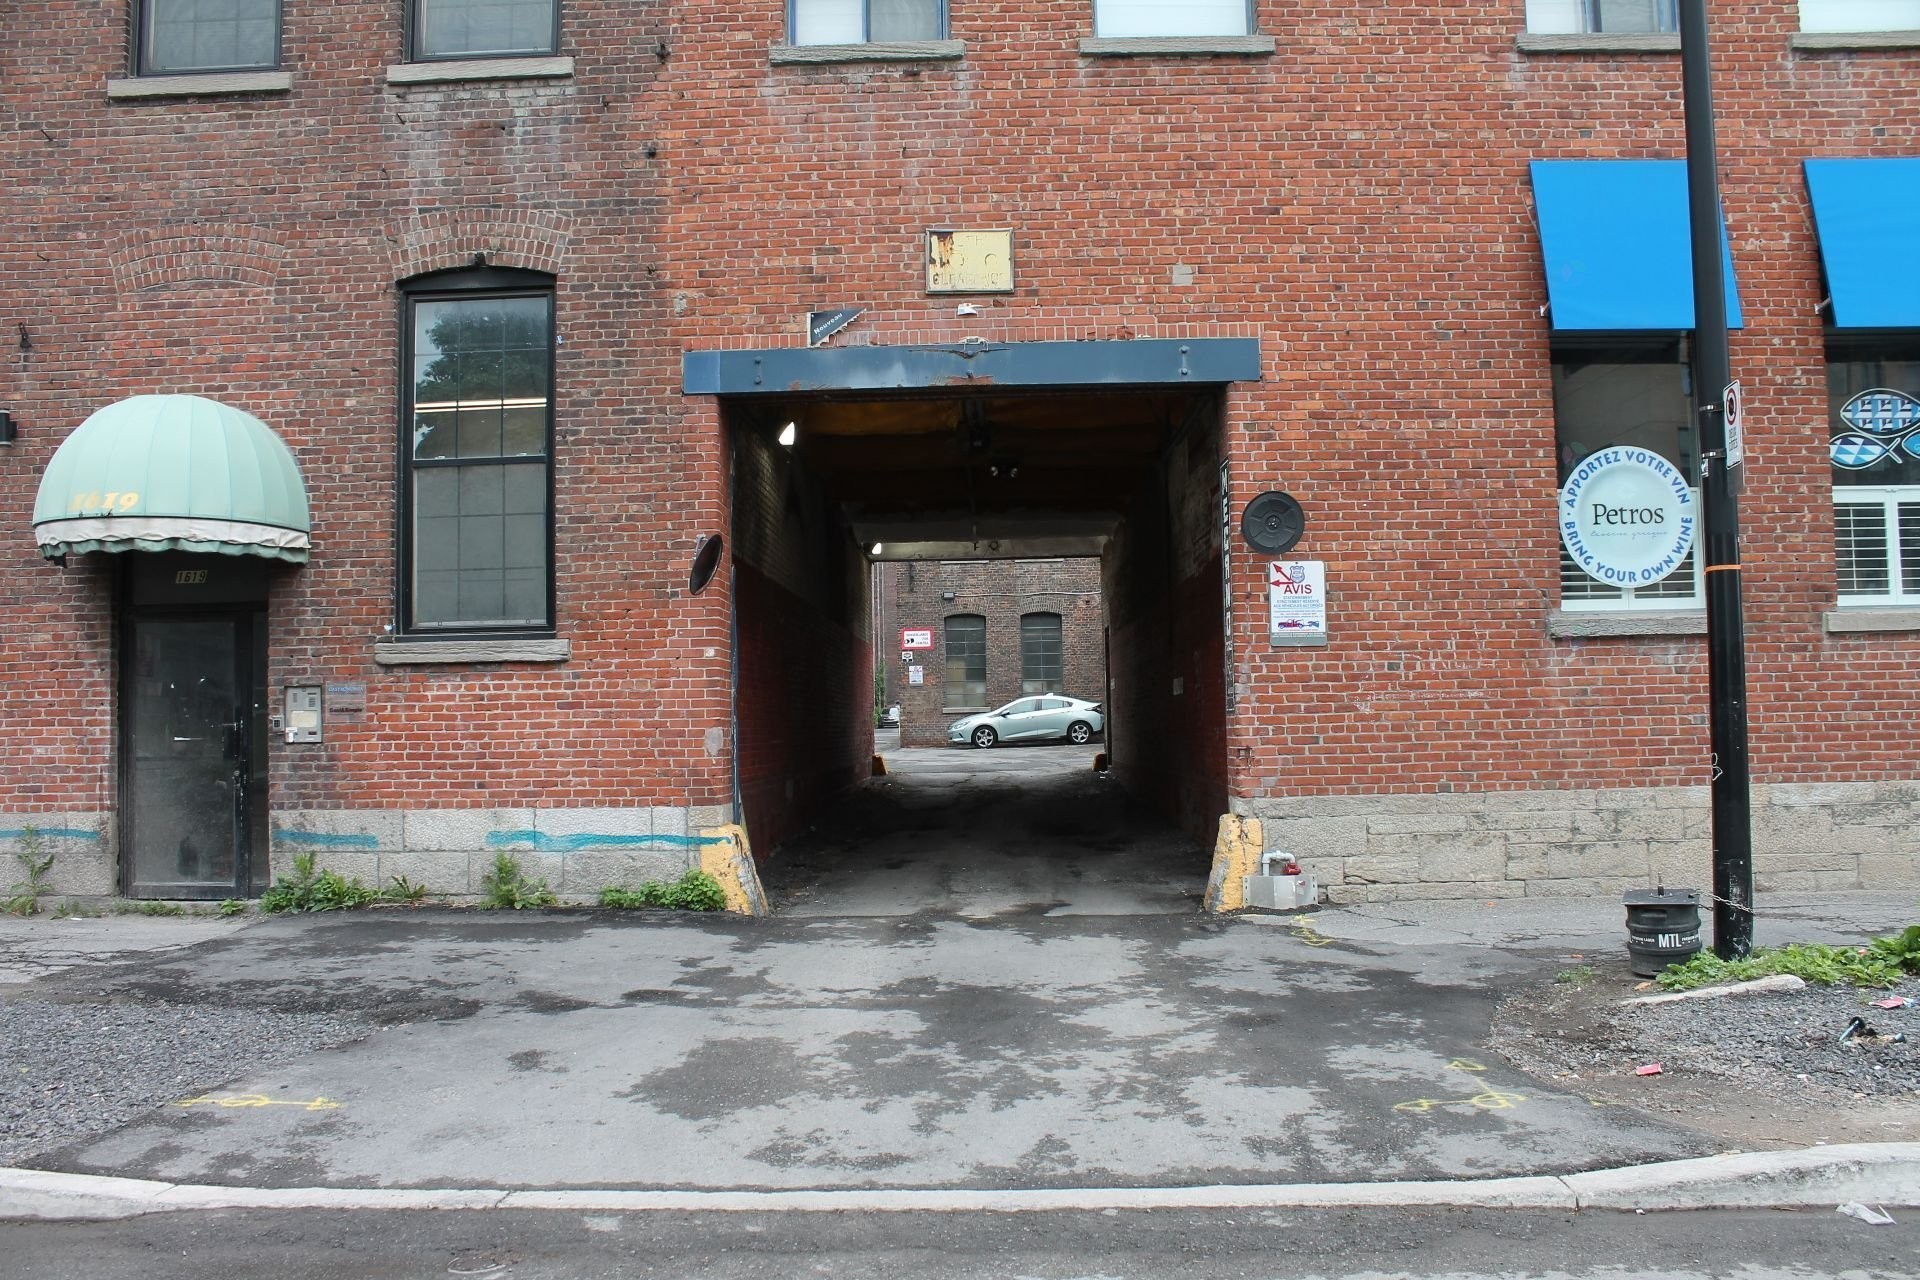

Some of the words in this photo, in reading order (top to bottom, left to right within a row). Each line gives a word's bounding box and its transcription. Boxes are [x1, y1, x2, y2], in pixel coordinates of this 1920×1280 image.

[813, 312, 843, 335] Nouveau
[1565, 451, 1621, 508] APPORTEZ
[1625, 450, 1672, 478] VOTRE
[1671, 477, 1690, 504] VIN
[67, 492, 139, 512] 1619
[1592, 504, 1664, 525] Petros
[1564, 521, 1594, 566] BRING
[1595, 562, 1637, 582] YOUR
[1641, 555, 1675, 581] OWN
[1672, 517, 1692, 555] WINE
[177, 571, 207, 583] 1619
[1284, 584, 1312, 594] AVIS
[1658, 933, 1682, 948] MTL
